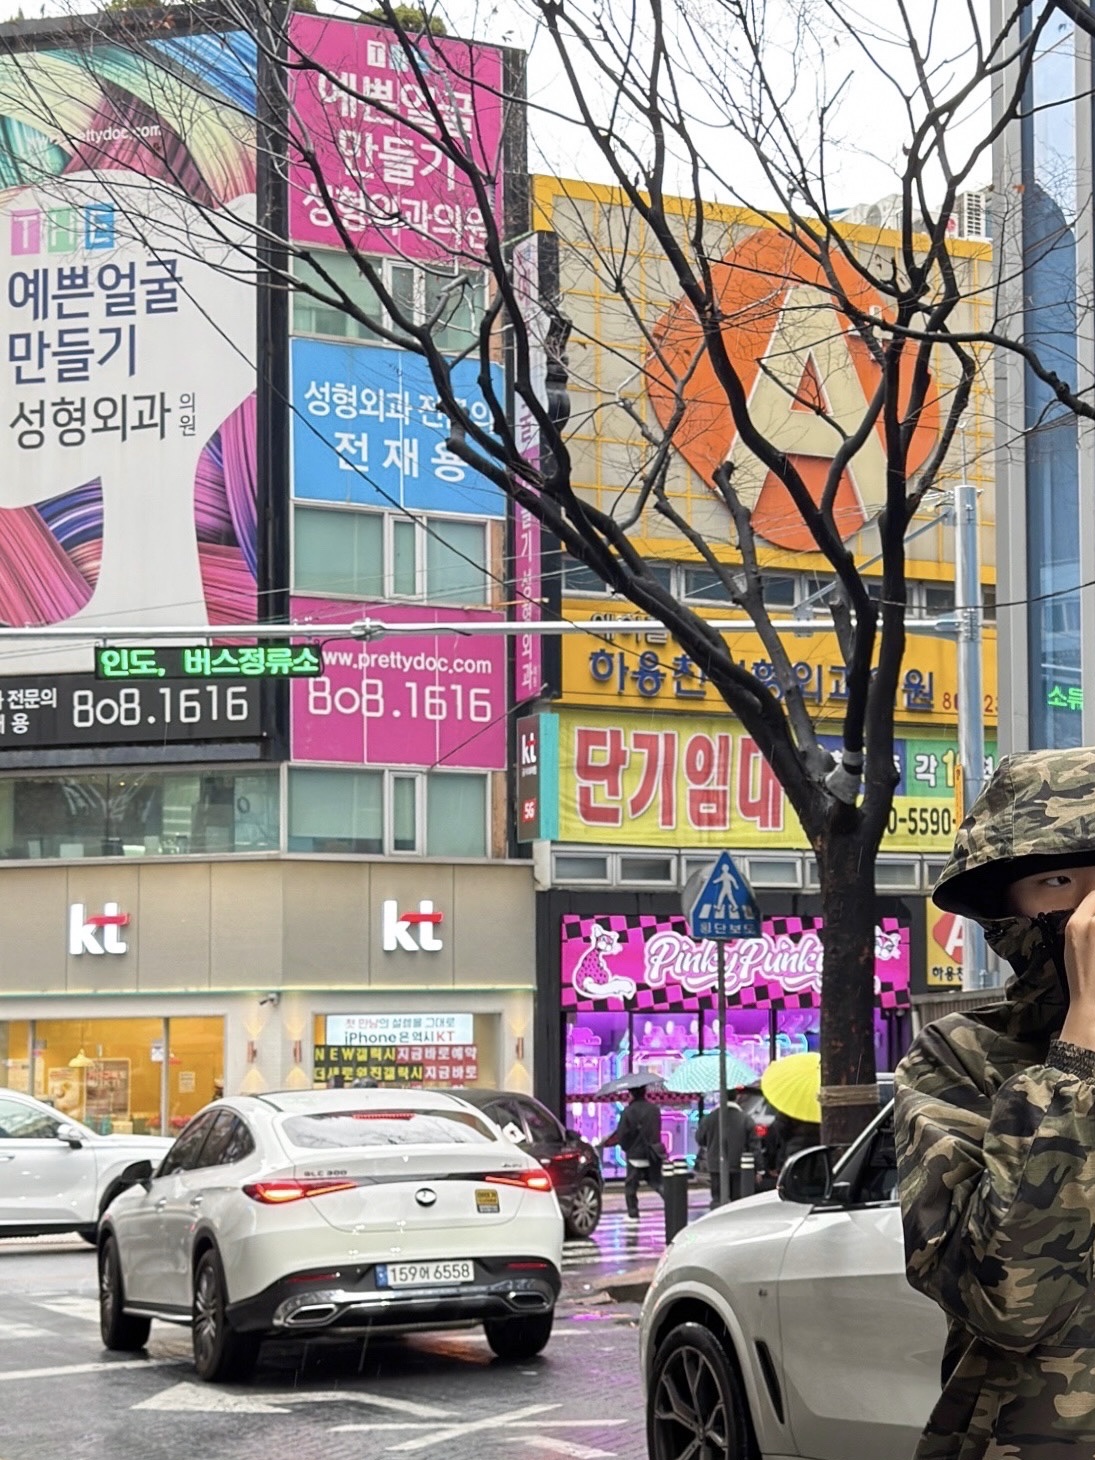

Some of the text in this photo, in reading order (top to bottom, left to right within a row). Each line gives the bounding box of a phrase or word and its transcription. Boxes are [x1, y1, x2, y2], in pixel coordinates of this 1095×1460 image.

[317, 71, 474, 140] 예쁜얼굴
[338, 129, 455, 192] 만들기
[12, 208, 113, 253] THE
[8, 259, 183, 321] 예쁜얼굴
[8, 324, 136, 385] 만들기
[9, 392, 196, 450] 성형외과 의원
[304, 380, 412, 425] 성형외과
[418, 394, 496, 434] 전의
[100, 648, 319, 677] 인도, 버스정류소
[7, 686, 58, 710] 전문의
[73, 684, 249, 728] 808.1616
[308, 676, 492, 723] 808.1616
[521, 732, 537, 765] kt
[575, 726, 785, 832] 단기임대
[68, 901, 131, 956] kt
[381, 899, 443, 953] kt
[434, 1262, 471, 1280] 6558
